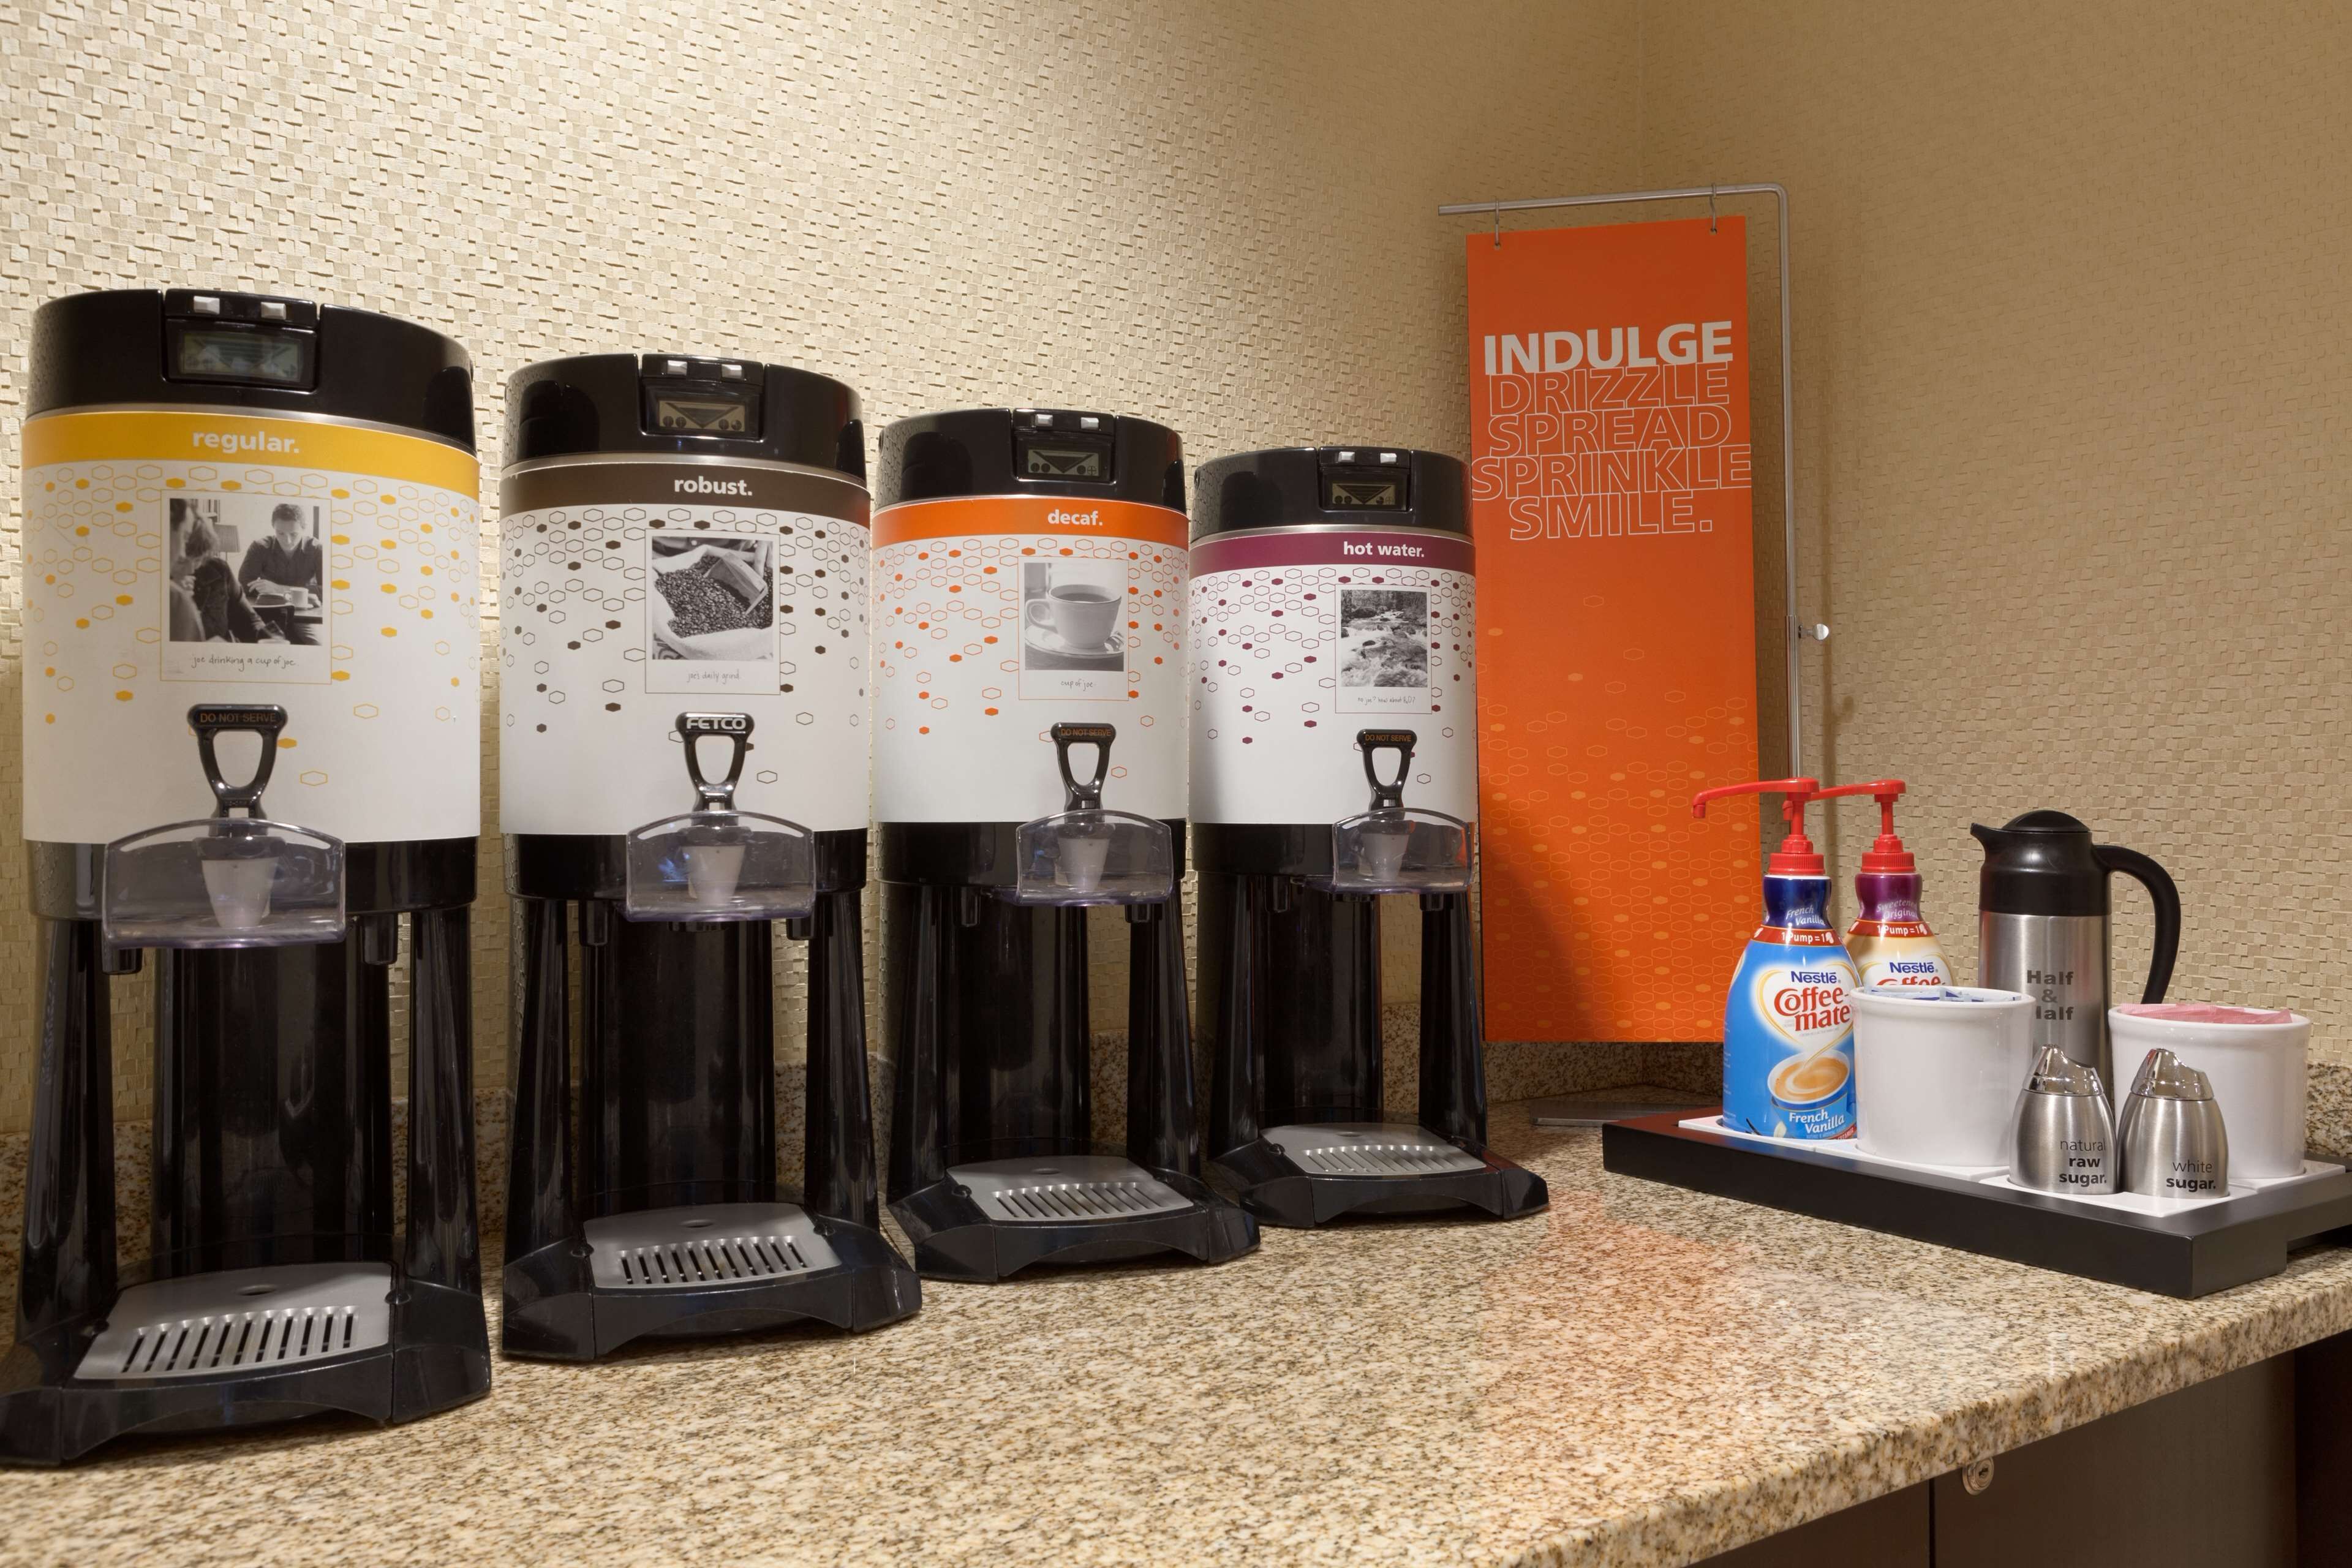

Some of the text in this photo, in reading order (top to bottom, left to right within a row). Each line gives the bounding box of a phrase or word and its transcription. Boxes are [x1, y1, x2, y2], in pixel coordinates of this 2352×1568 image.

[1484, 321, 1733, 375] INDULGE
[1490, 361, 1730, 416] DRIZZLE
[1488, 405, 1731, 458] SPREAD
[192, 431, 300, 454] regular.
[1472, 445, 1752, 501] SPRINKLE
[674, 476, 753, 496] robust.
[1048, 510, 1102, 526] decaf.
[1510, 490, 1713, 540] SMILE.
[1344, 541, 1424, 557] hot water.
[191, 655, 205, 668] joe
[209, 655, 244, 672] drinking
[255, 658, 271, 666] cup
[219, 714, 239, 722] NOT
[243, 714, 276, 722] SERVE
[687, 717, 746, 729] FETCO
[1786, 905, 1814, 920] French
[1795, 915, 1825, 926] Vanilla
[1789, 932, 1813, 944] Pump
[1882, 925, 1909, 936] Pump
[2027, 970, 2074, 985] Half
[2041, 989, 2057, 1003] &
[1795, 1005, 1850, 1031] mate
[1789, 1109, 1828, 1123] French
[1805, 1114, 1844, 1134] Vanilla
[2060, 1138, 2106, 1151] natural
[2069, 1158, 2100, 1167] raw
[2173, 1160, 2212, 1172] white
[2059, 1173, 2106, 1187] sugar.
[2166, 1177, 2216, 1192] sugar.
